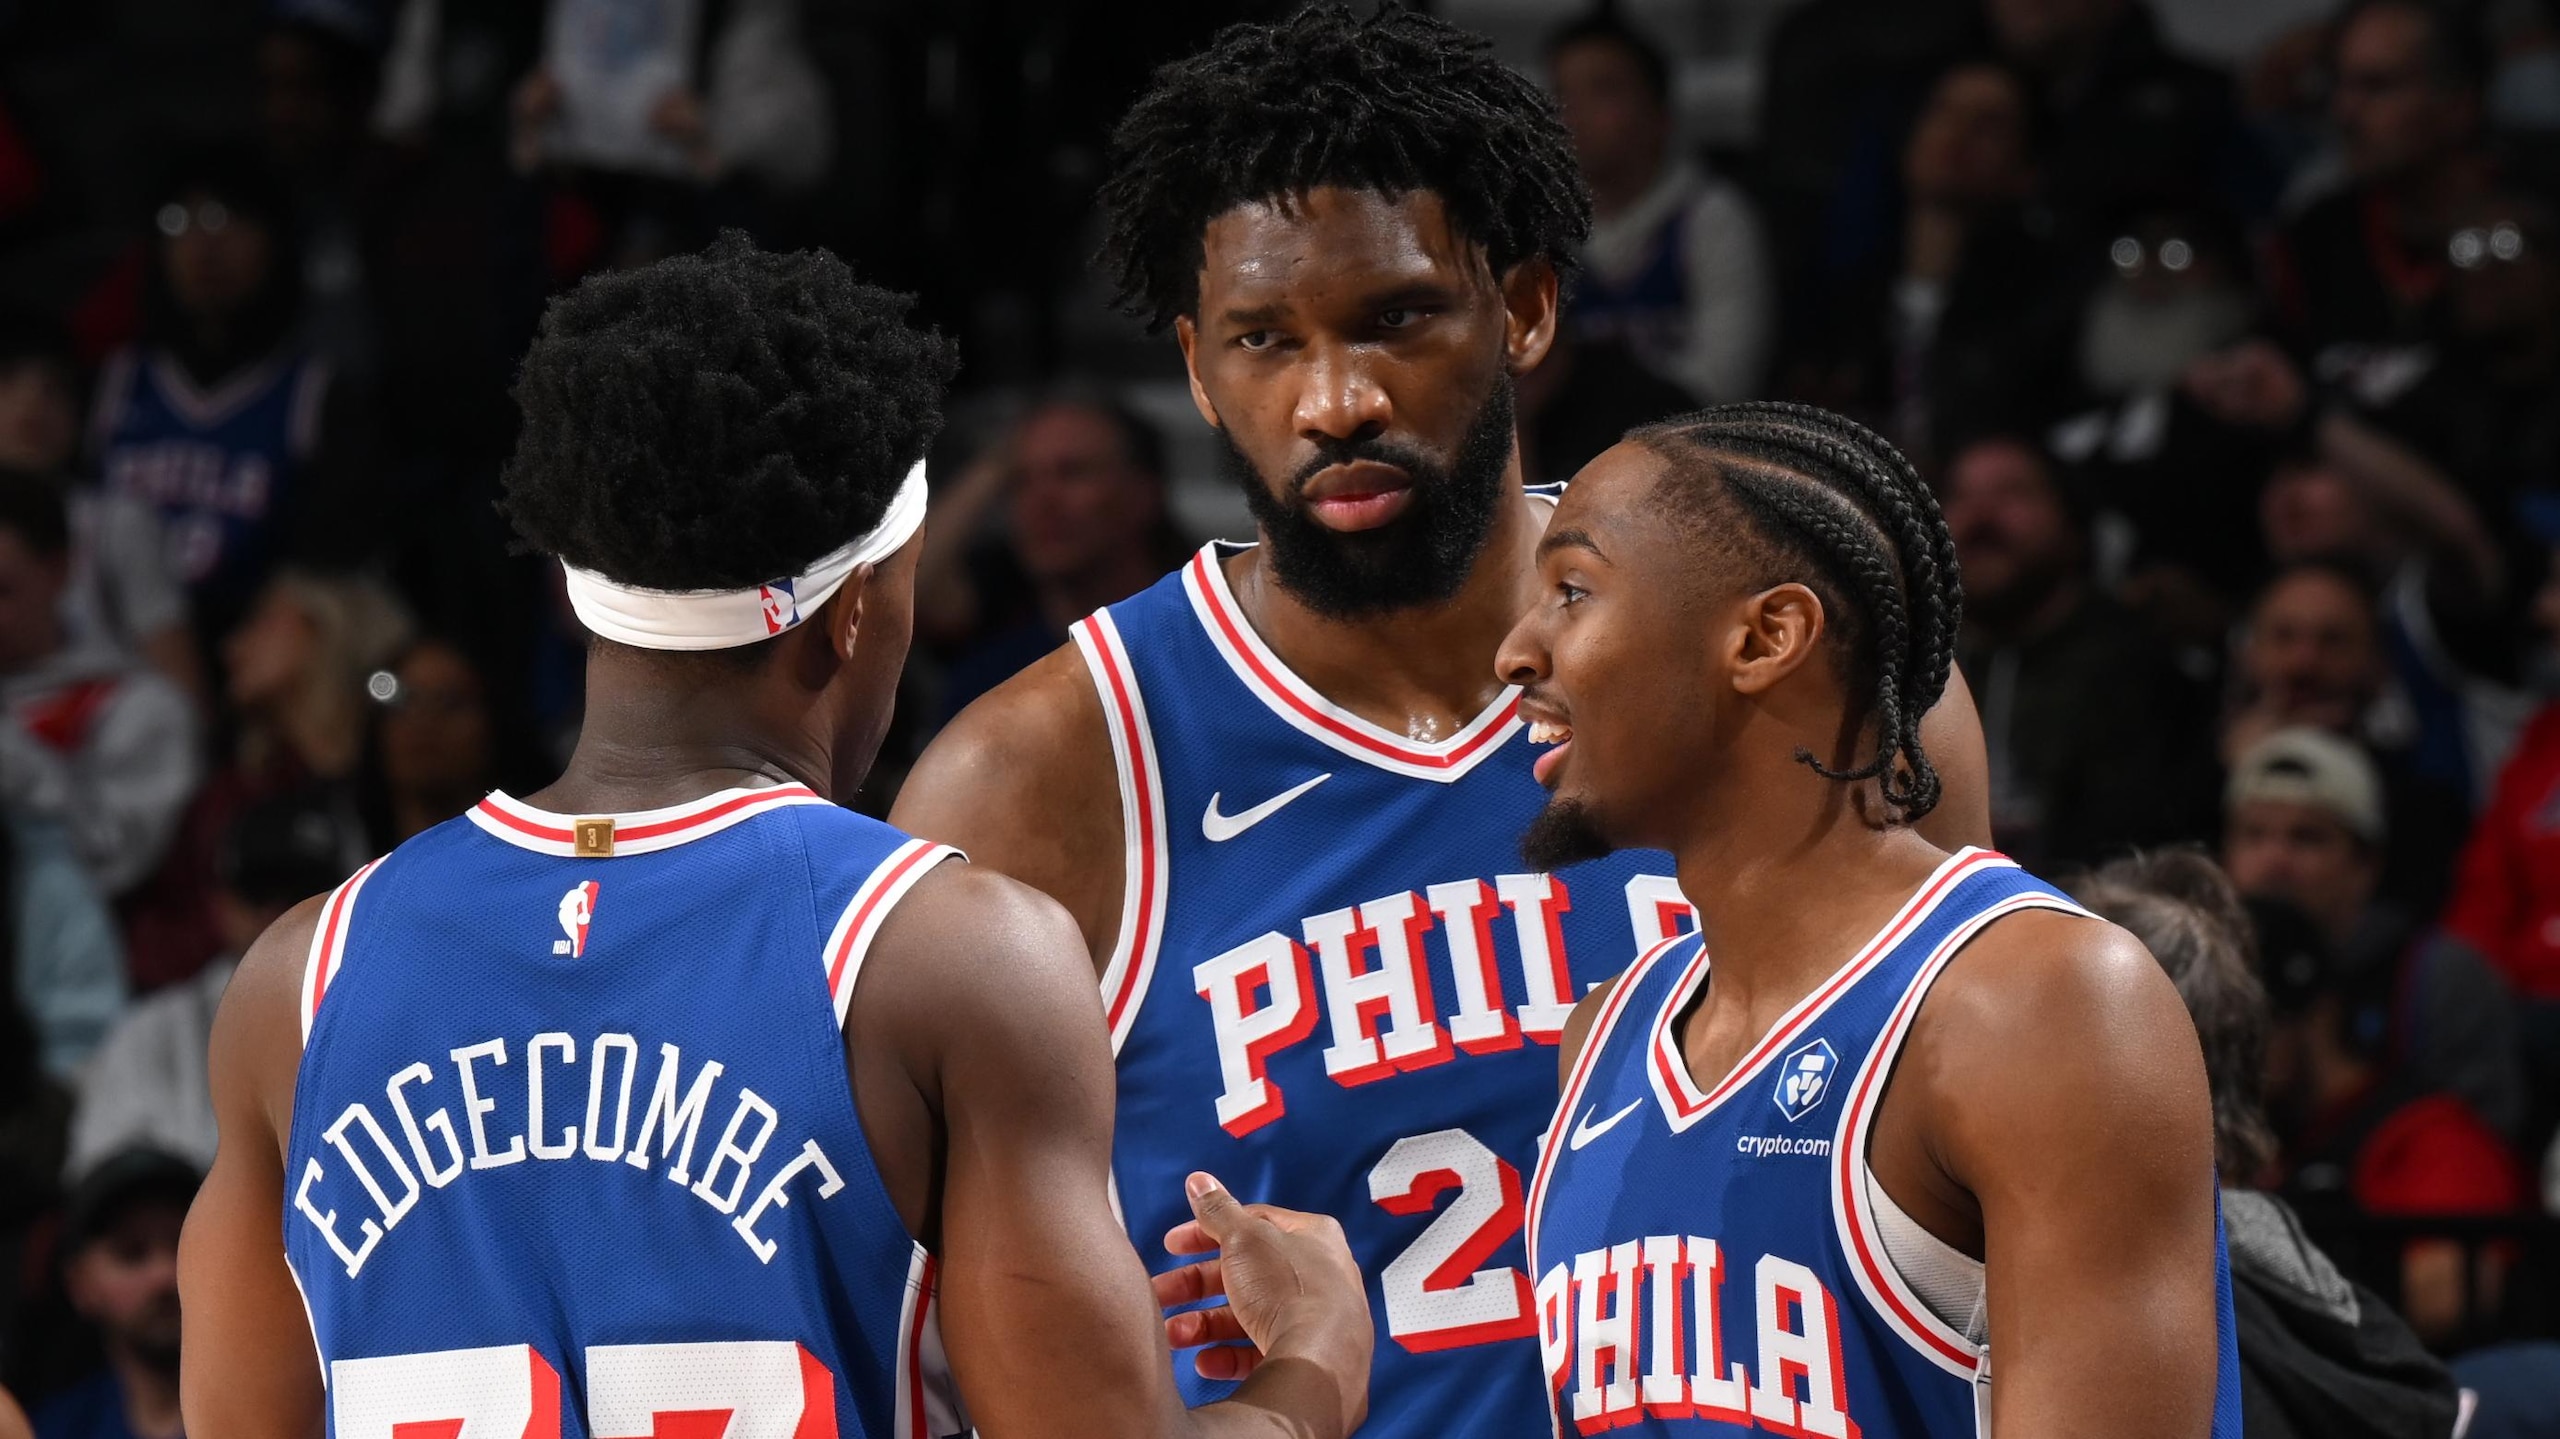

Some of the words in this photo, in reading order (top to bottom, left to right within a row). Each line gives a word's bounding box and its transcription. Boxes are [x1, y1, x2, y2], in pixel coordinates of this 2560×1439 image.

[552, 940, 571, 955] NBA
[294, 1031, 846, 1280] EDGECOMBE
[1367, 1127, 1548, 1354] 2
[1737, 1134, 1831, 1158] crypto.com
[1536, 1234, 1862, 1439] PHILA
